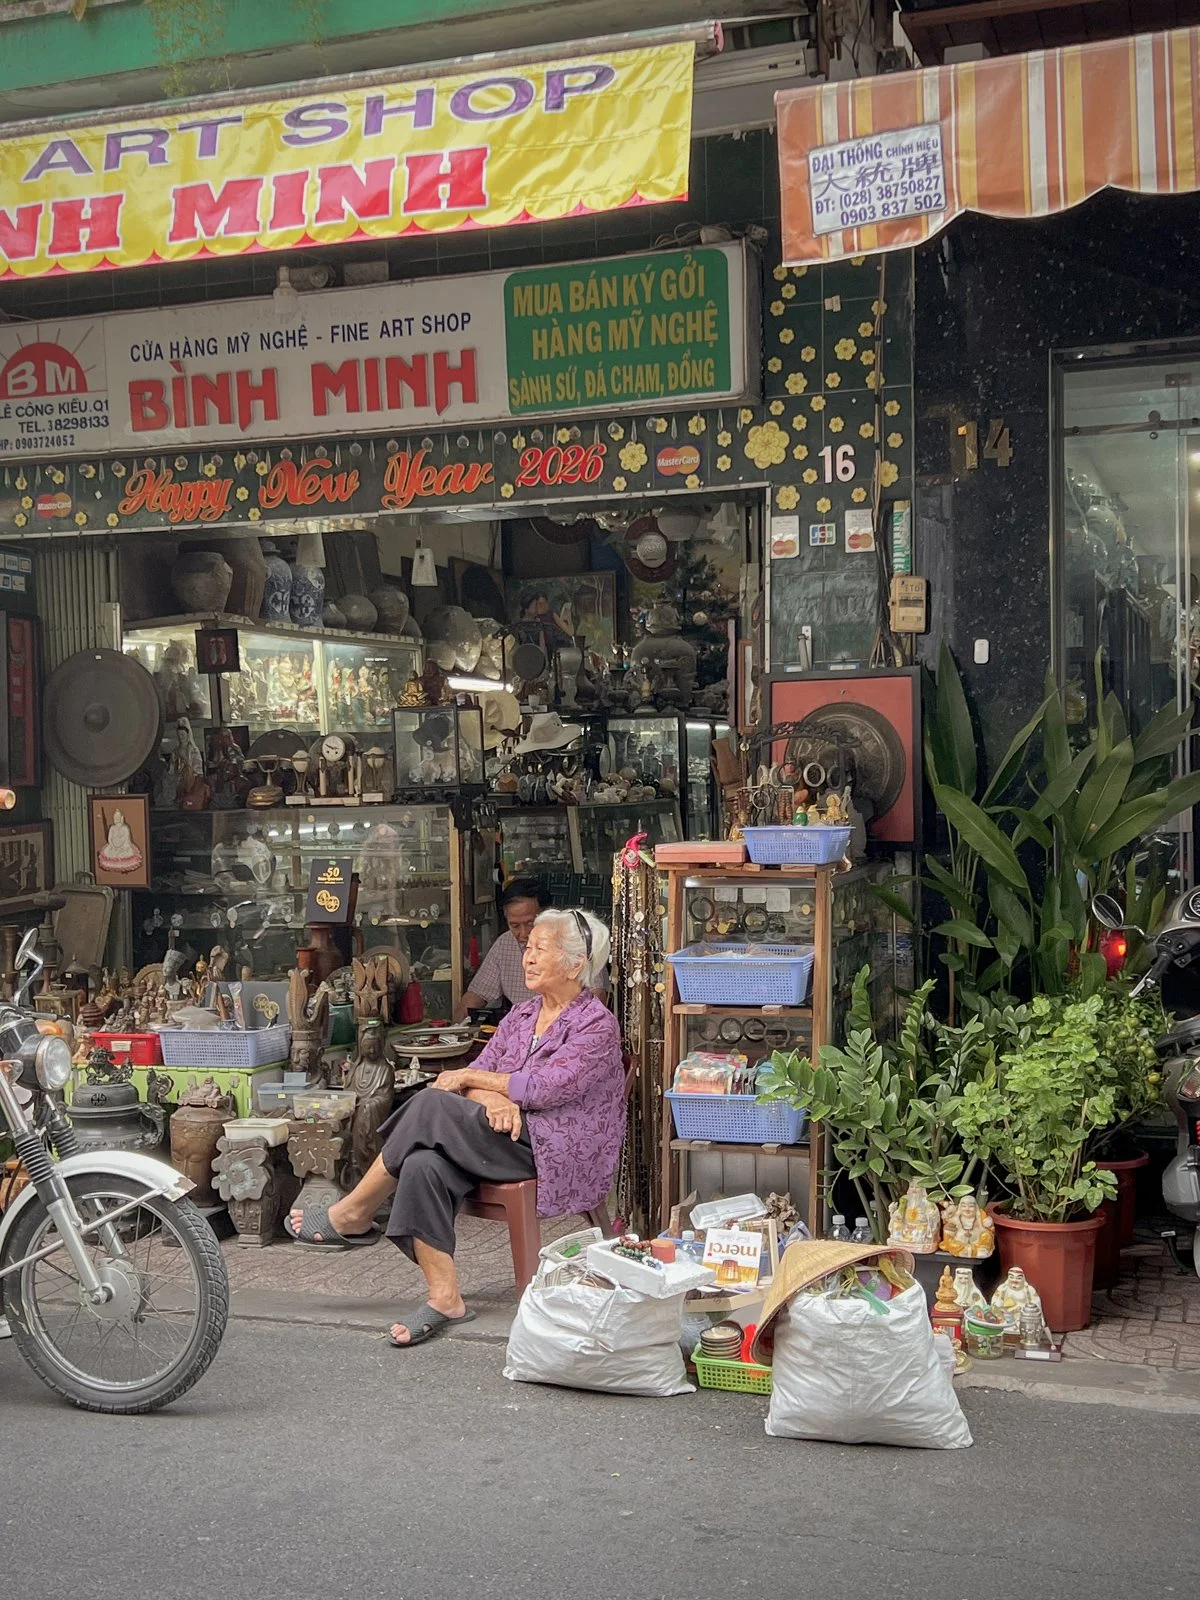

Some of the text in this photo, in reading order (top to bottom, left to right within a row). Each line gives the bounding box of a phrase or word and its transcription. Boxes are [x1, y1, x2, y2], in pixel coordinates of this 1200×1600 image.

[22, 64, 616, 182] ART SHOP
[812, 138, 939, 175] ĐẠI THỐNG CHÍNH HIỆU
[168, 146, 489, 243] MINH
[815, 175, 941, 215] ĐT: (028) 38750827
[840, 193, 943, 226] 0903 837 502
[513, 253, 705, 318] MUA BÁN KÝ GỞI
[130, 339, 164, 363] CỬA
[170, 336, 218, 360] HÀNG
[227, 331, 250, 354] MỸ
[260, 324, 309, 351] NGHỆ
[330, 321, 370, 344] FINE
[379, 317, 415, 339] ART
[422, 311, 472, 334] SHOP
[532, 300, 719, 361] HÀNG MỸ NGHỆ
[7, 359, 77, 396] BM
[128, 347, 479, 432] BÌNH MINH
[508, 348, 715, 408] SÀNH SỨ, ĐÁ CHẠM, ĐỒNG
[15, 401, 55, 418] CÔNG
[15, 435, 75, 450] 0903724052
[657, 451, 700, 468] MasterCard
[957, 418, 1014, 470] 14
[118, 443, 607, 523] Happy New Year 2026
[818, 444, 857, 484] 16
[327, 866, 340, 878] 50
[707, 1242, 758, 1257] merci
